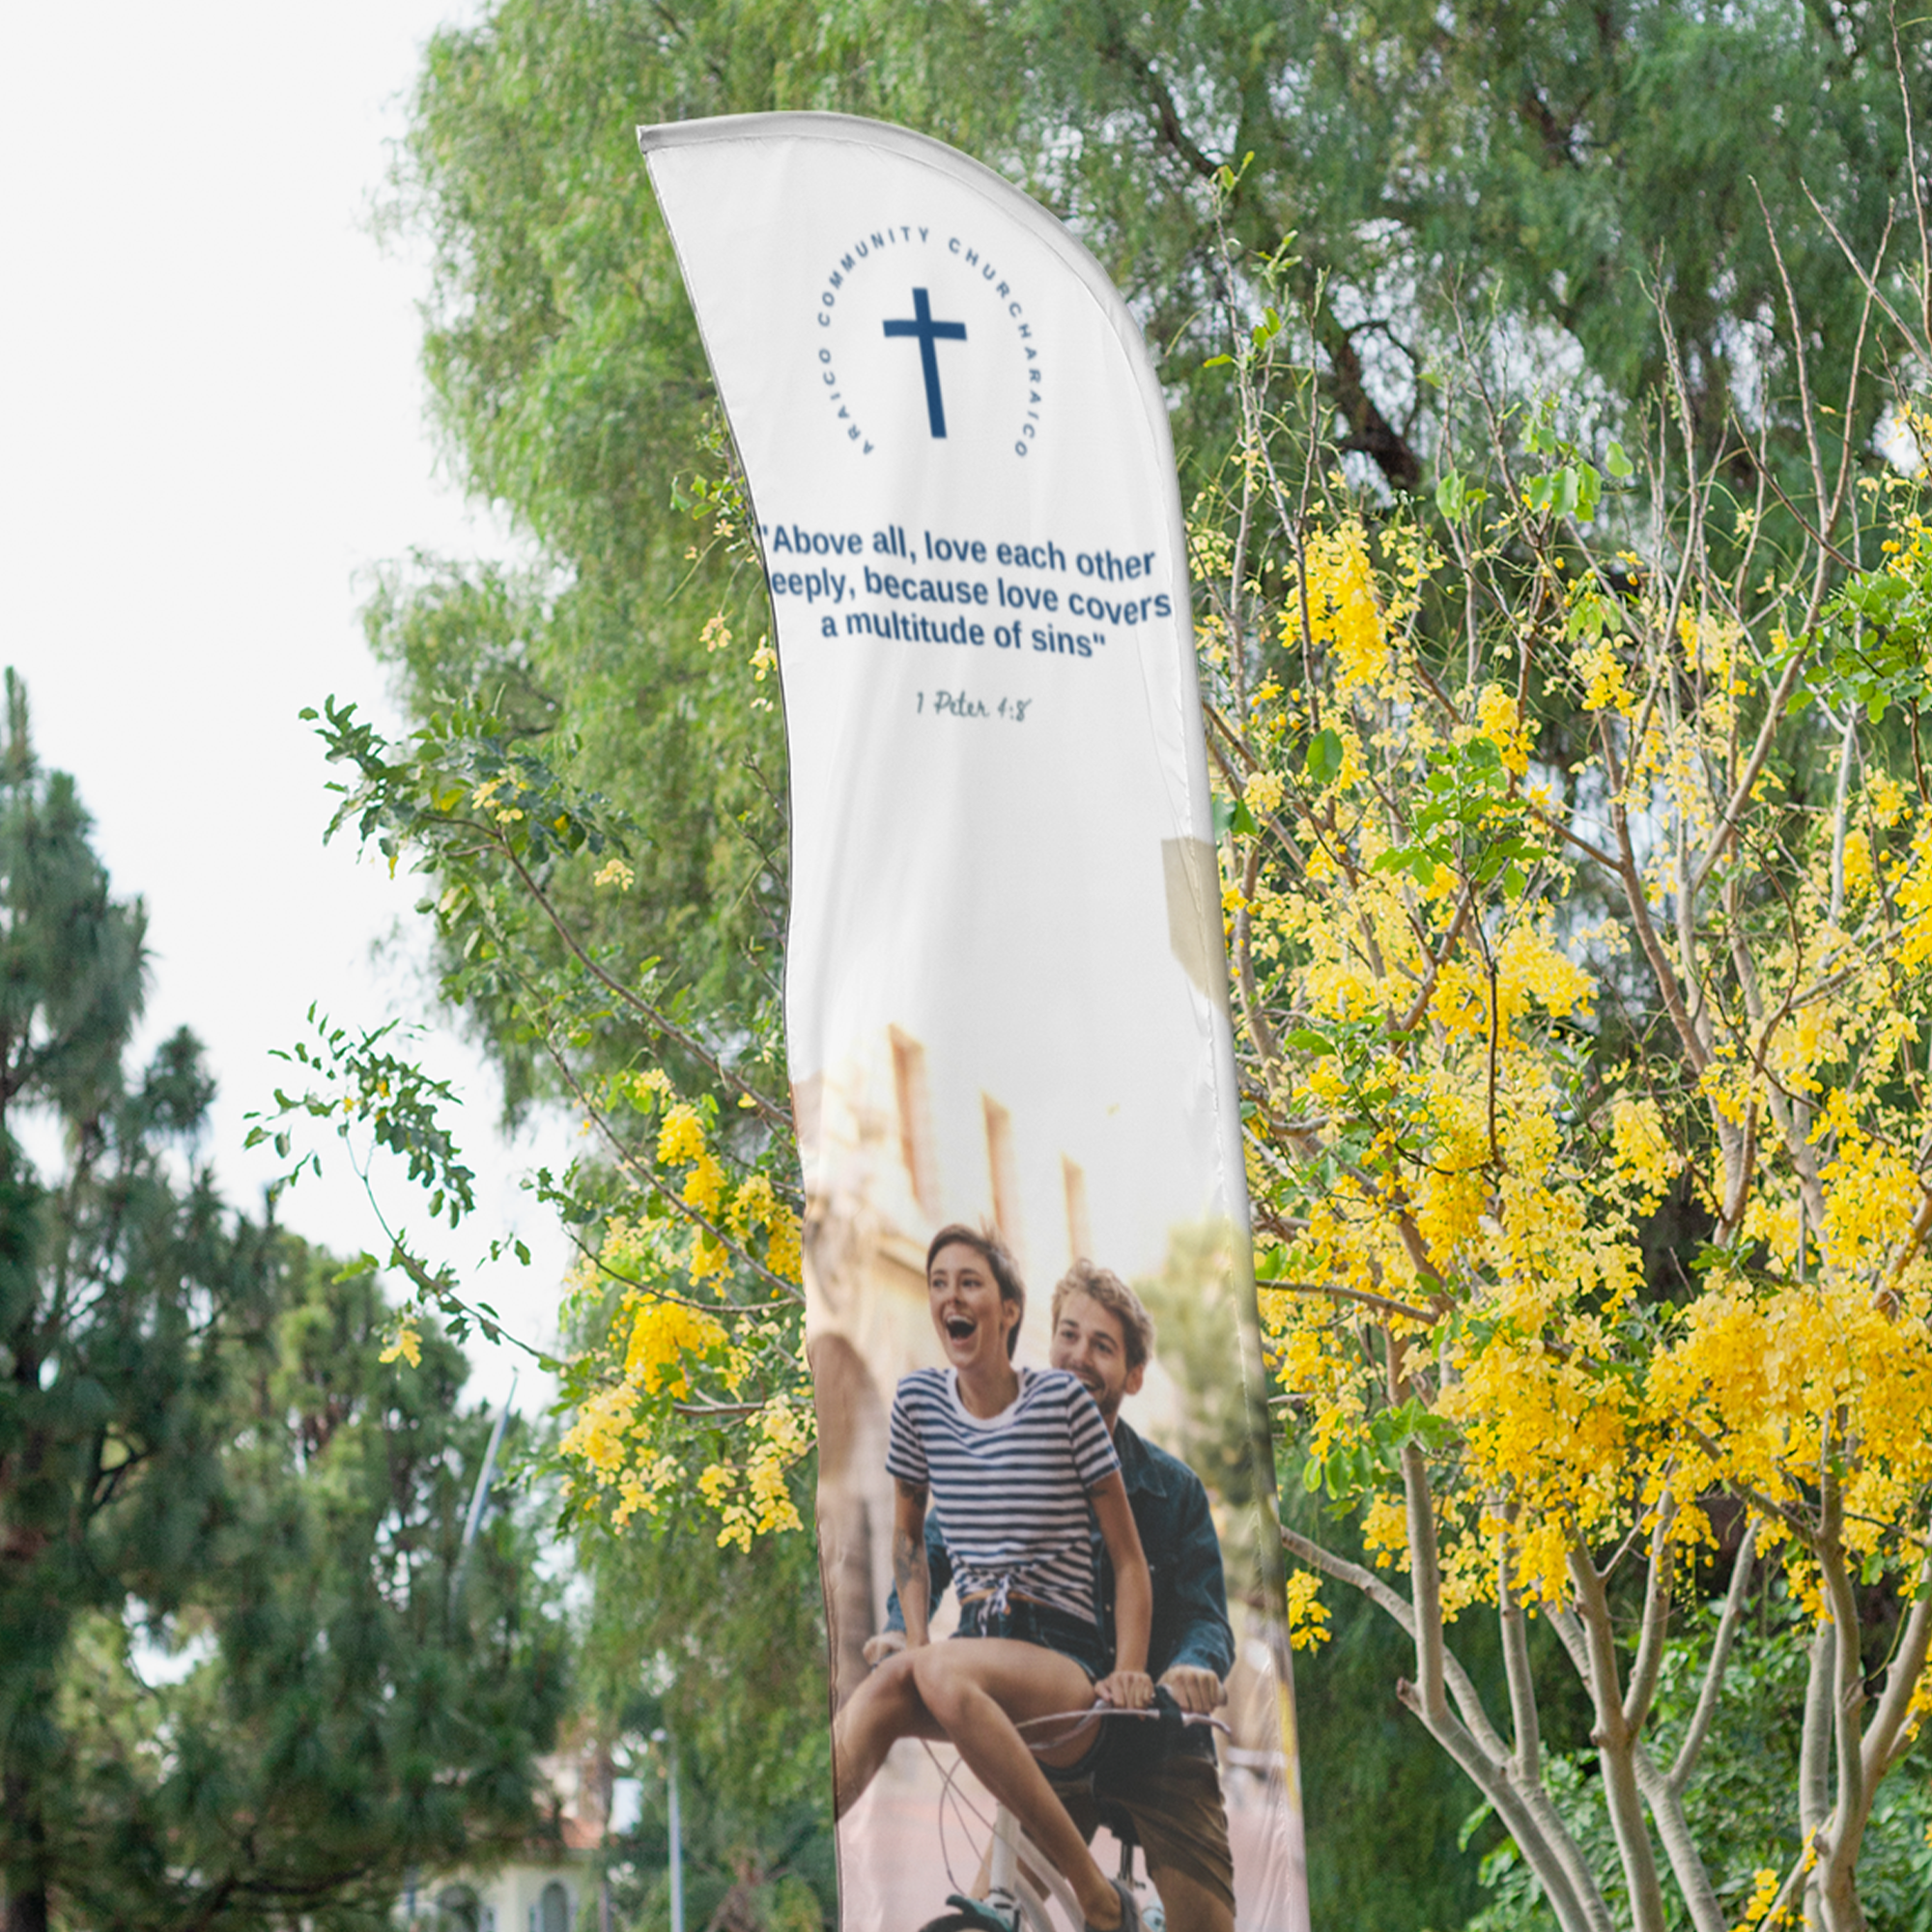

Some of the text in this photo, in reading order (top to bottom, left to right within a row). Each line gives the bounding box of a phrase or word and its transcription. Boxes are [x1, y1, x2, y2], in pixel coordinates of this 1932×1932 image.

[817, 226, 929, 328] COMMUNITY
[817, 348, 875, 456] ARAICO
[871, 524, 918, 565] all,
[923, 529, 987, 563] love
[996, 539, 1066, 573] each
[1075, 549, 1156, 582] other
[763, 564, 1173, 626] eeply, because love covers
[820, 610, 1106, 658] a multitude of sins"
[916, 689, 1033, 723] 1 Peter 4:8
